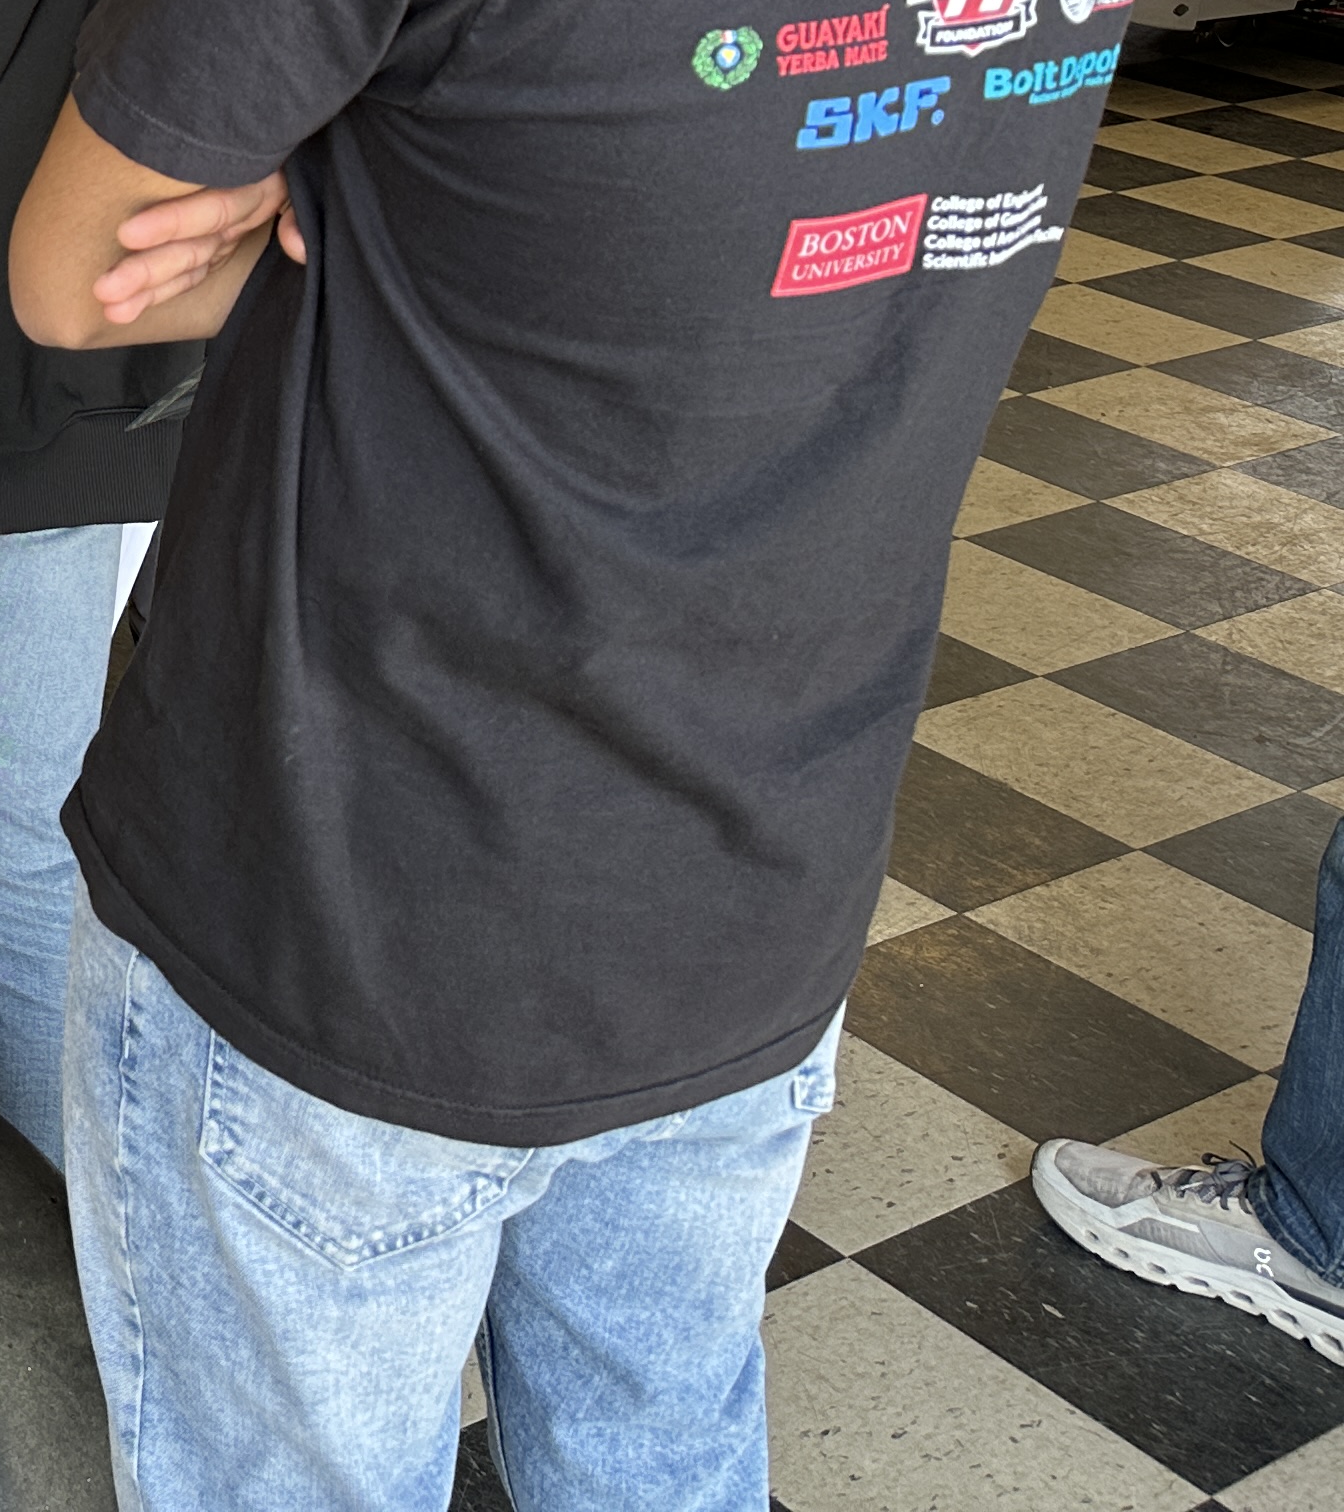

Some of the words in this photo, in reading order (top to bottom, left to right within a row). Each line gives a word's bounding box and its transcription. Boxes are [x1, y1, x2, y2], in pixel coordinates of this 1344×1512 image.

[935, 20, 1014, 44] FOUNDATION
[776, 48, 840, 78] YERBA
[844, 40, 889, 68] MATE
[931, 195, 985, 213] College
[985, 193, 1004, 210] of
[797, 211, 914, 258] BOSTON
[926, 214, 984, 233] College
[983, 213, 1001, 229] of
[923, 234, 982, 252] College
[982, 232, 998, 249] of
[791, 242, 905, 282] UNIVERSITY
